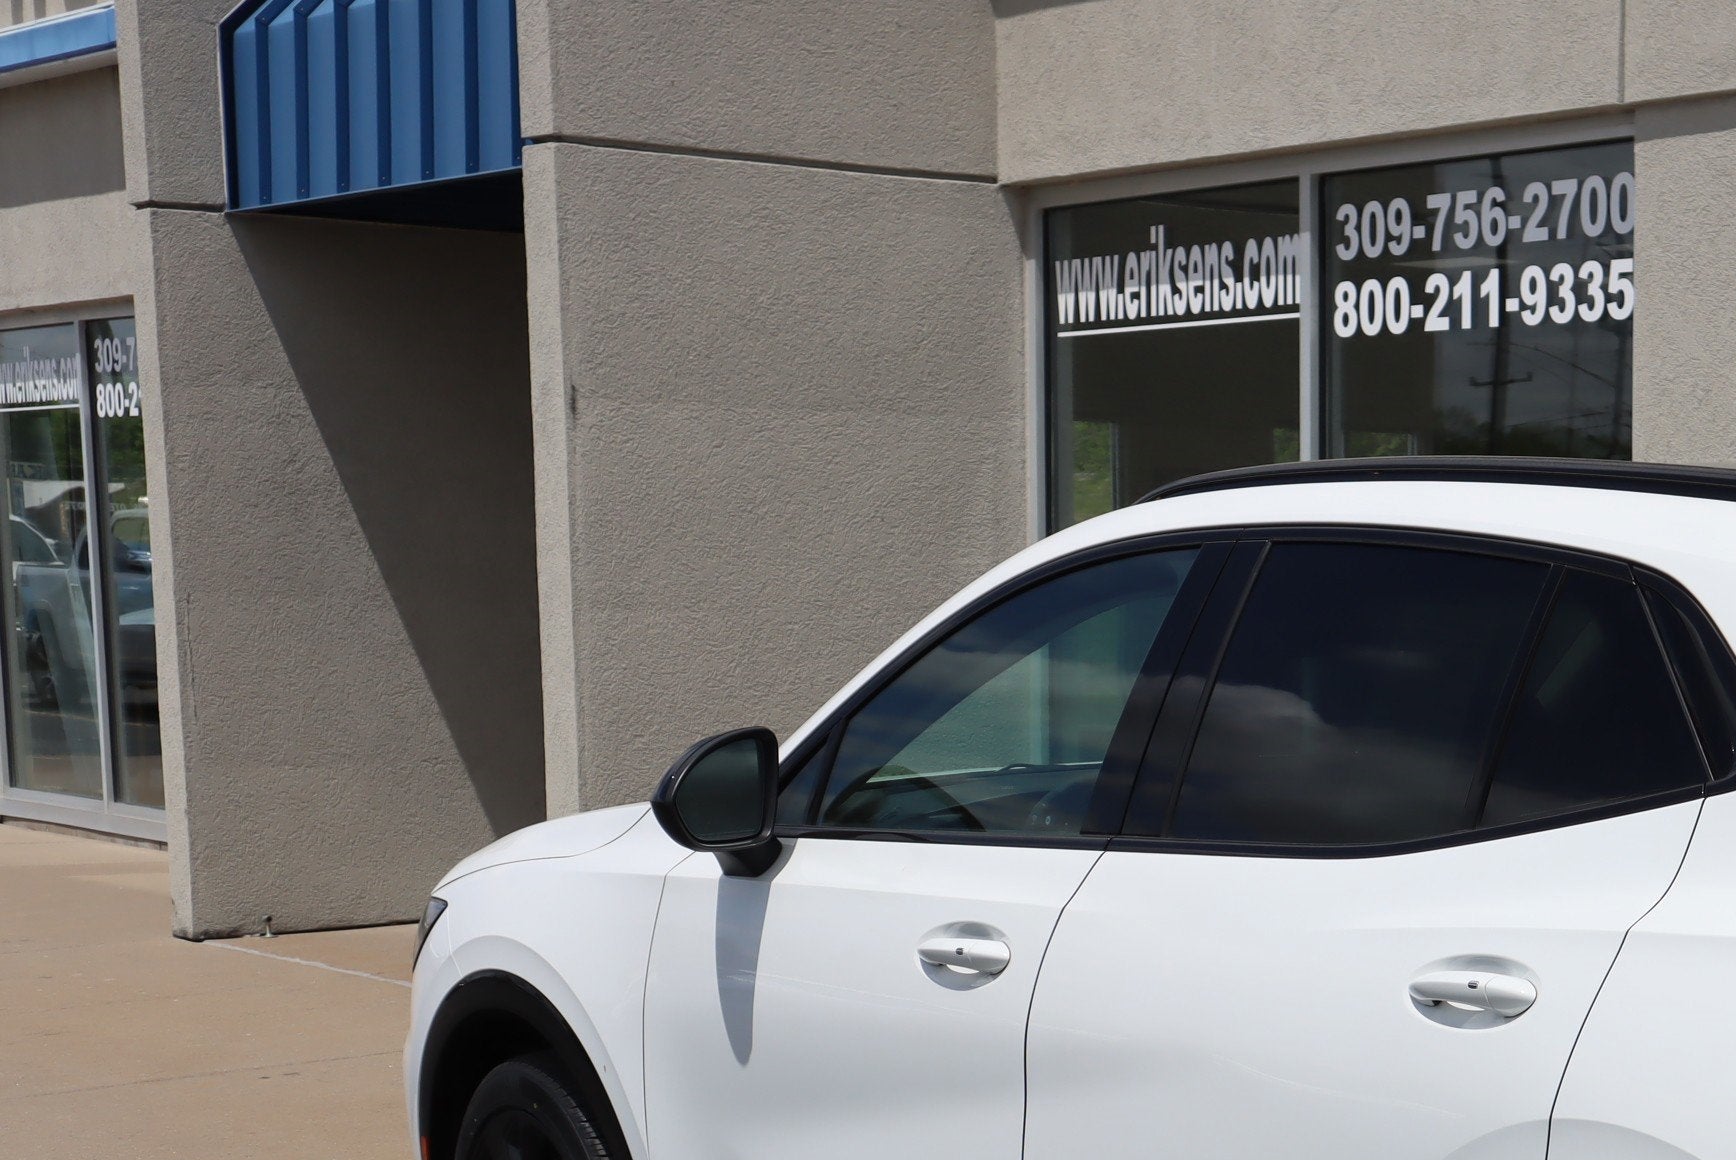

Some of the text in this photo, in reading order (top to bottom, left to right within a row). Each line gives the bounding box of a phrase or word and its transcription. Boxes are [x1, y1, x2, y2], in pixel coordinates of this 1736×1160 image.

[1335, 171, 1635, 261] 309-756-2700
[1054, 224, 1301, 326] www.eriksens.com
[1333, 257, 1634, 338] 800-211-9335
[93, 337, 136, 373] 309-7
[96, 382, 141, 418] 800-2
